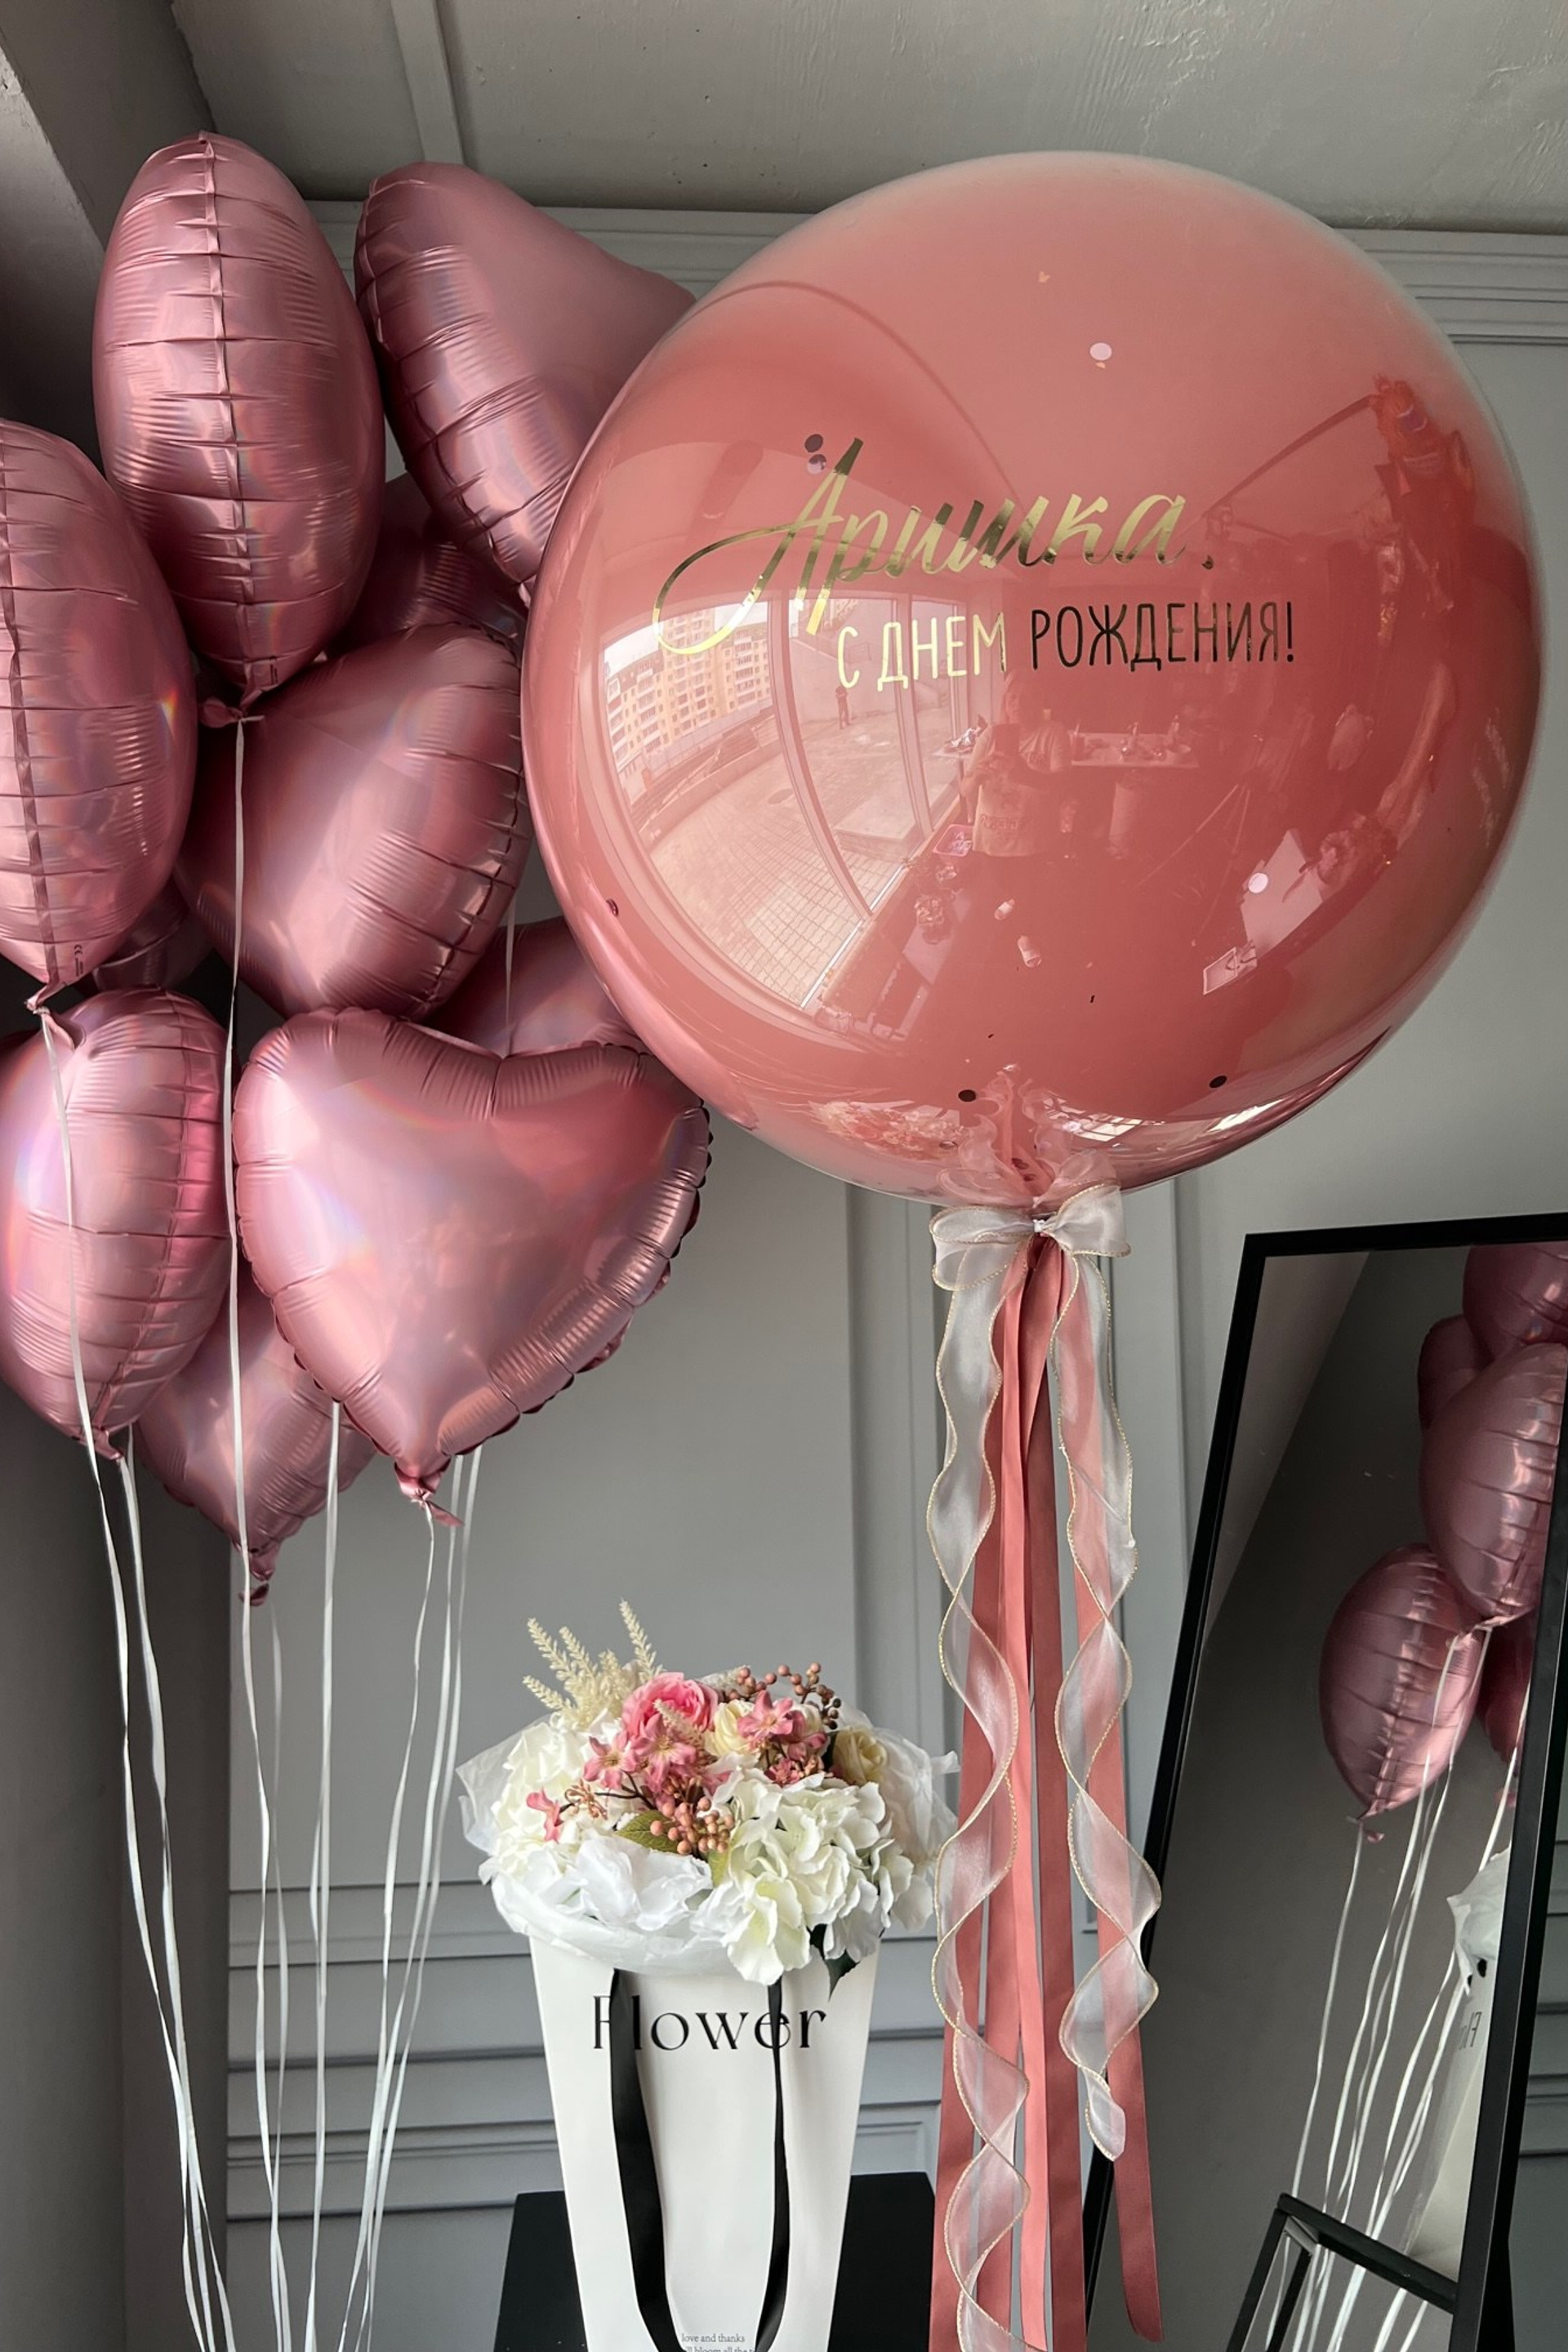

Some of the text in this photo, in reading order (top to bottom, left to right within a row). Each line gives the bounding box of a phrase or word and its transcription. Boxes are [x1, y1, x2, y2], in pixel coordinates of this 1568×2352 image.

[837, 601, 1294, 692] С ДНЕМ РОЖДЕНИЯ!
[681, 2333, 745, 2343] love and thanks
